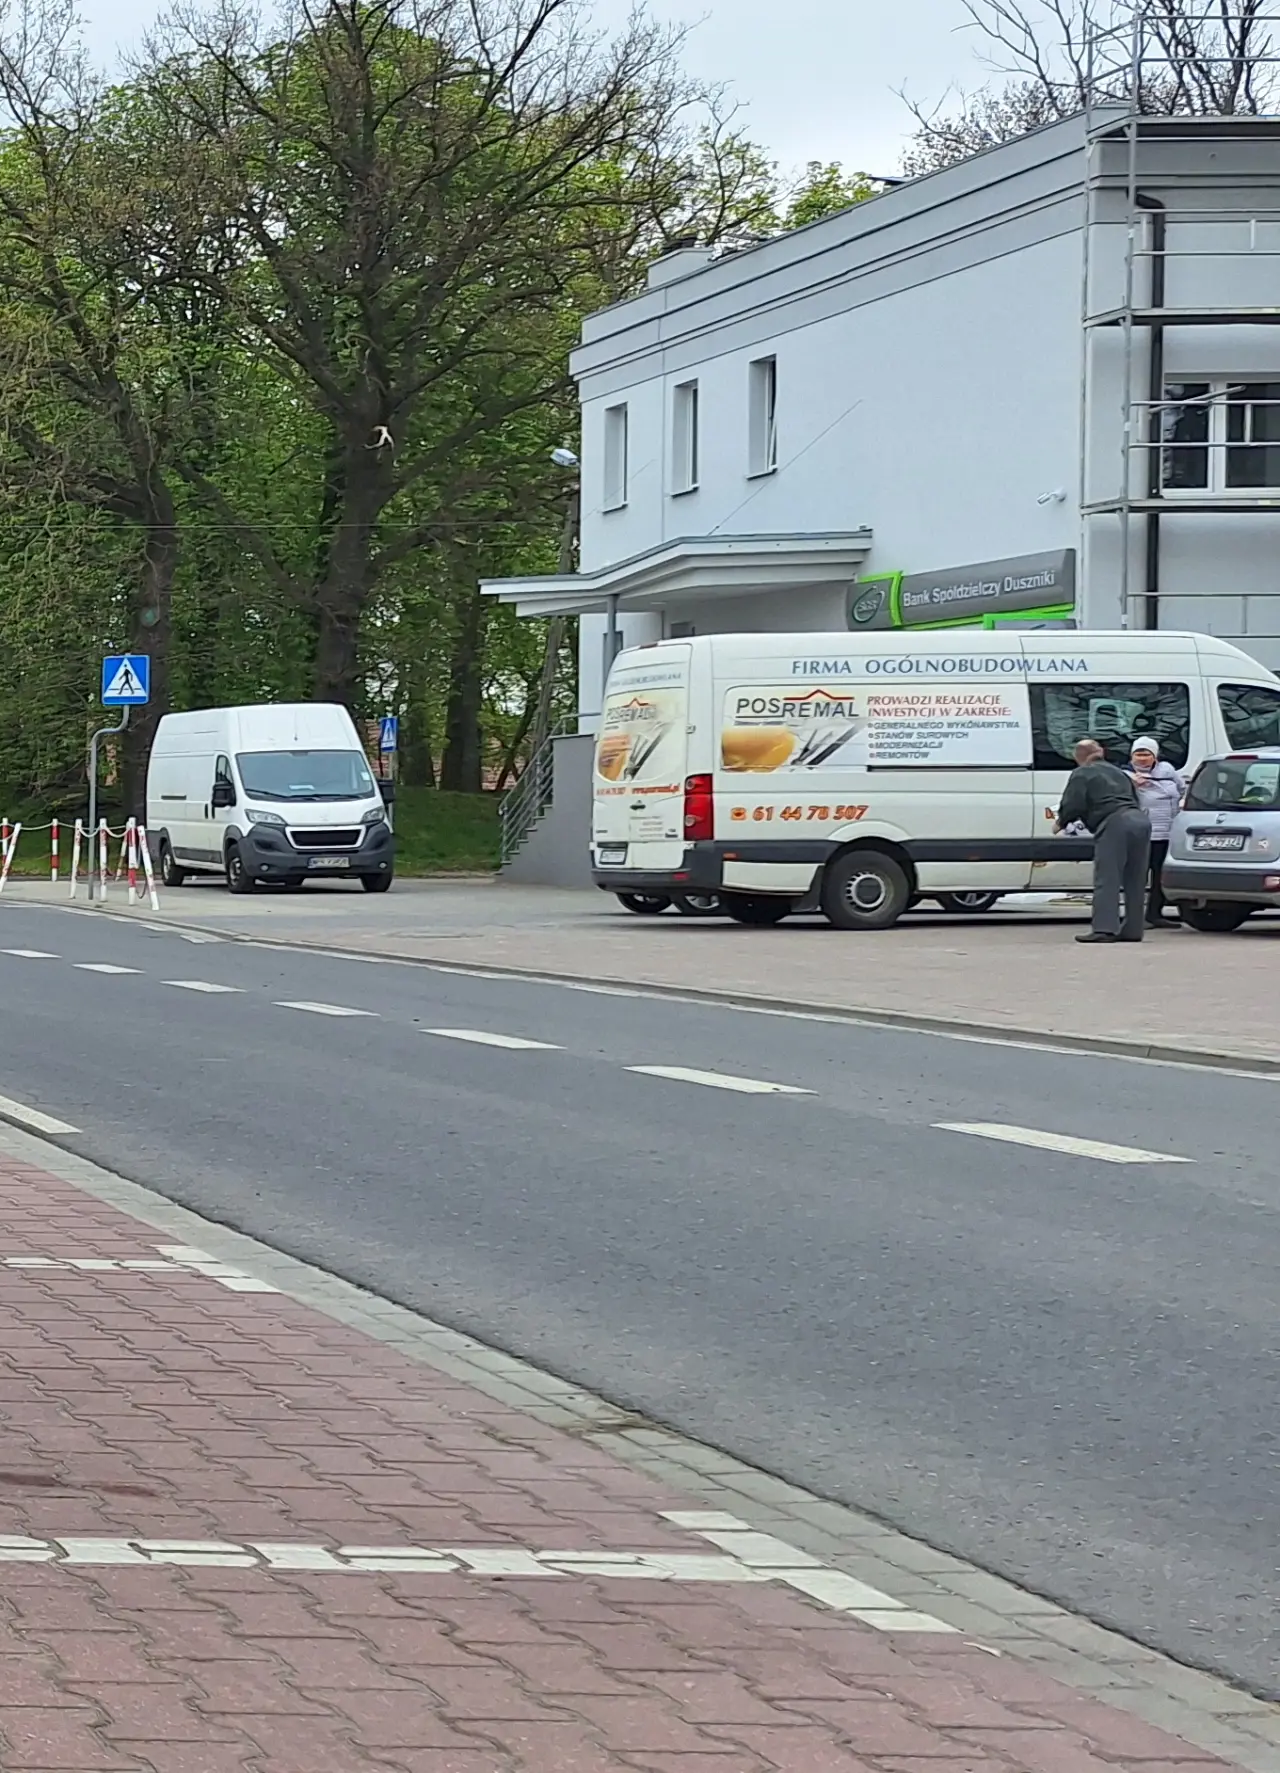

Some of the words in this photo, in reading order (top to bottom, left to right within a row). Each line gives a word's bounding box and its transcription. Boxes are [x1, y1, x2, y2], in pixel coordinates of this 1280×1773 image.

[903, 587, 930, 608] Bank
[932, 579, 1001, 604] Spółdzielczy
[1004, 569, 1055, 592] Duszniki
[792, 660, 852, 675] FIRMA
[865, 654, 1089, 674] OGÓLNOBUDOWLANA
[866, 695, 931, 706] PROWADZI
[935, 694, 1001, 706] REALIZACJE
[736, 697, 860, 718] POSREMAL
[867, 706, 936, 718] INWESTYCJI
[939, 707, 952, 717] W
[873, 721, 944, 730] GENERALNEGO
[916, 731, 969, 740] SUROWYCH
[752, 805, 775, 821] 61
[779, 805, 802, 821] 44
[832, 804, 870, 821] 507
